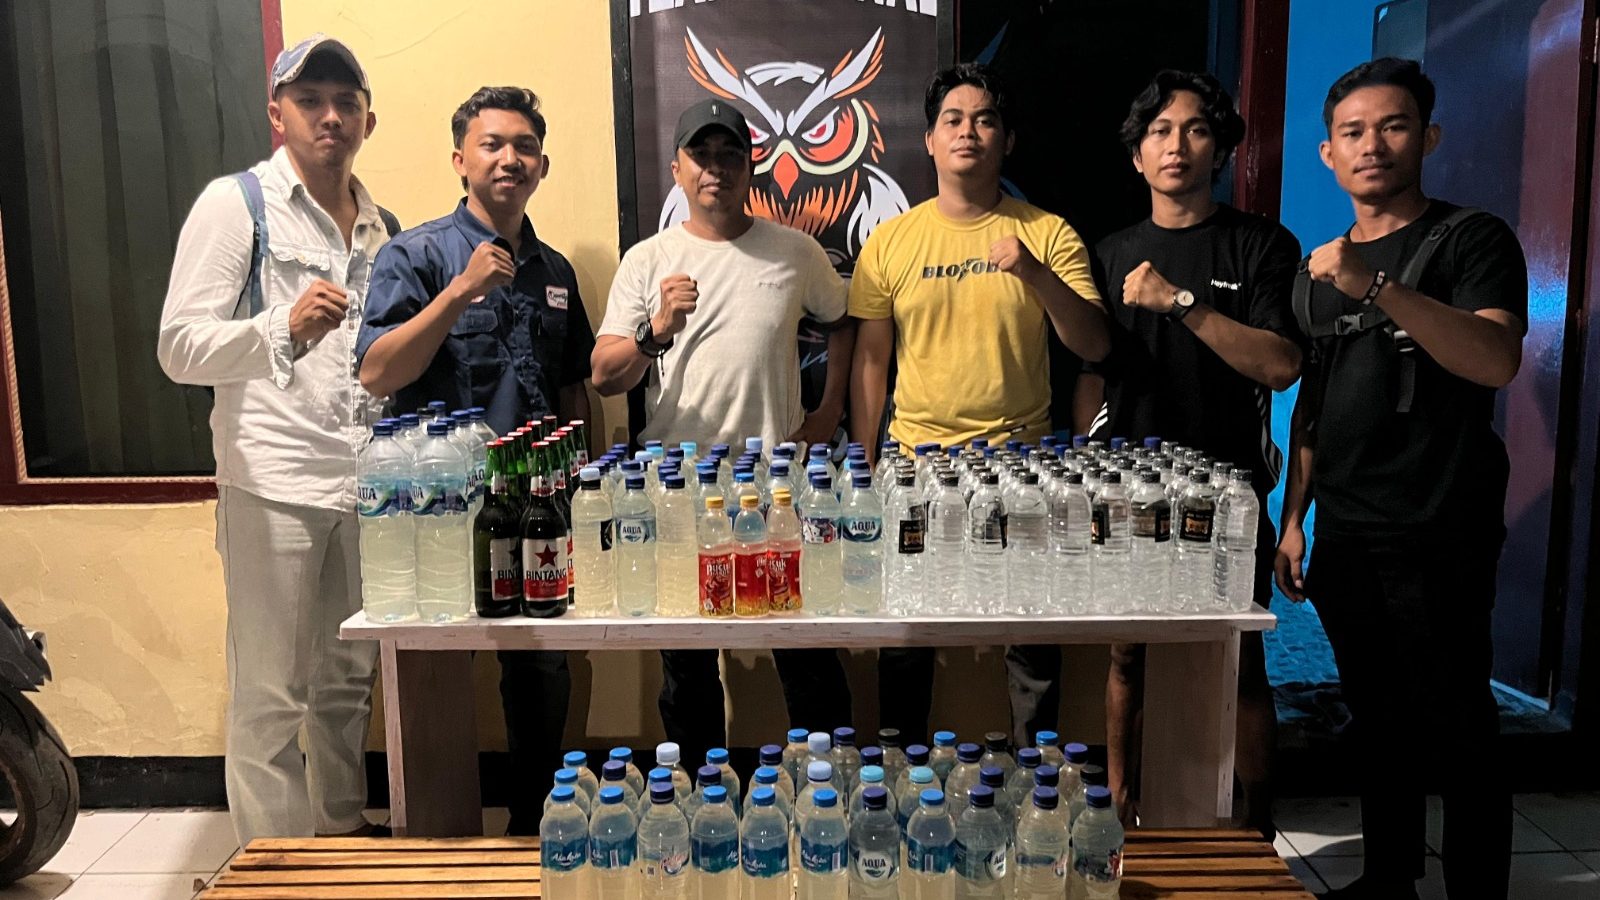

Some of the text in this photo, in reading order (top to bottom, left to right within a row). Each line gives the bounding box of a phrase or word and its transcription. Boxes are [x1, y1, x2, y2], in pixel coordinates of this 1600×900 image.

[851, 520, 876, 533] AQUA
[525, 567, 567, 581] BINTANG
[861, 857, 887, 869] AQUA
